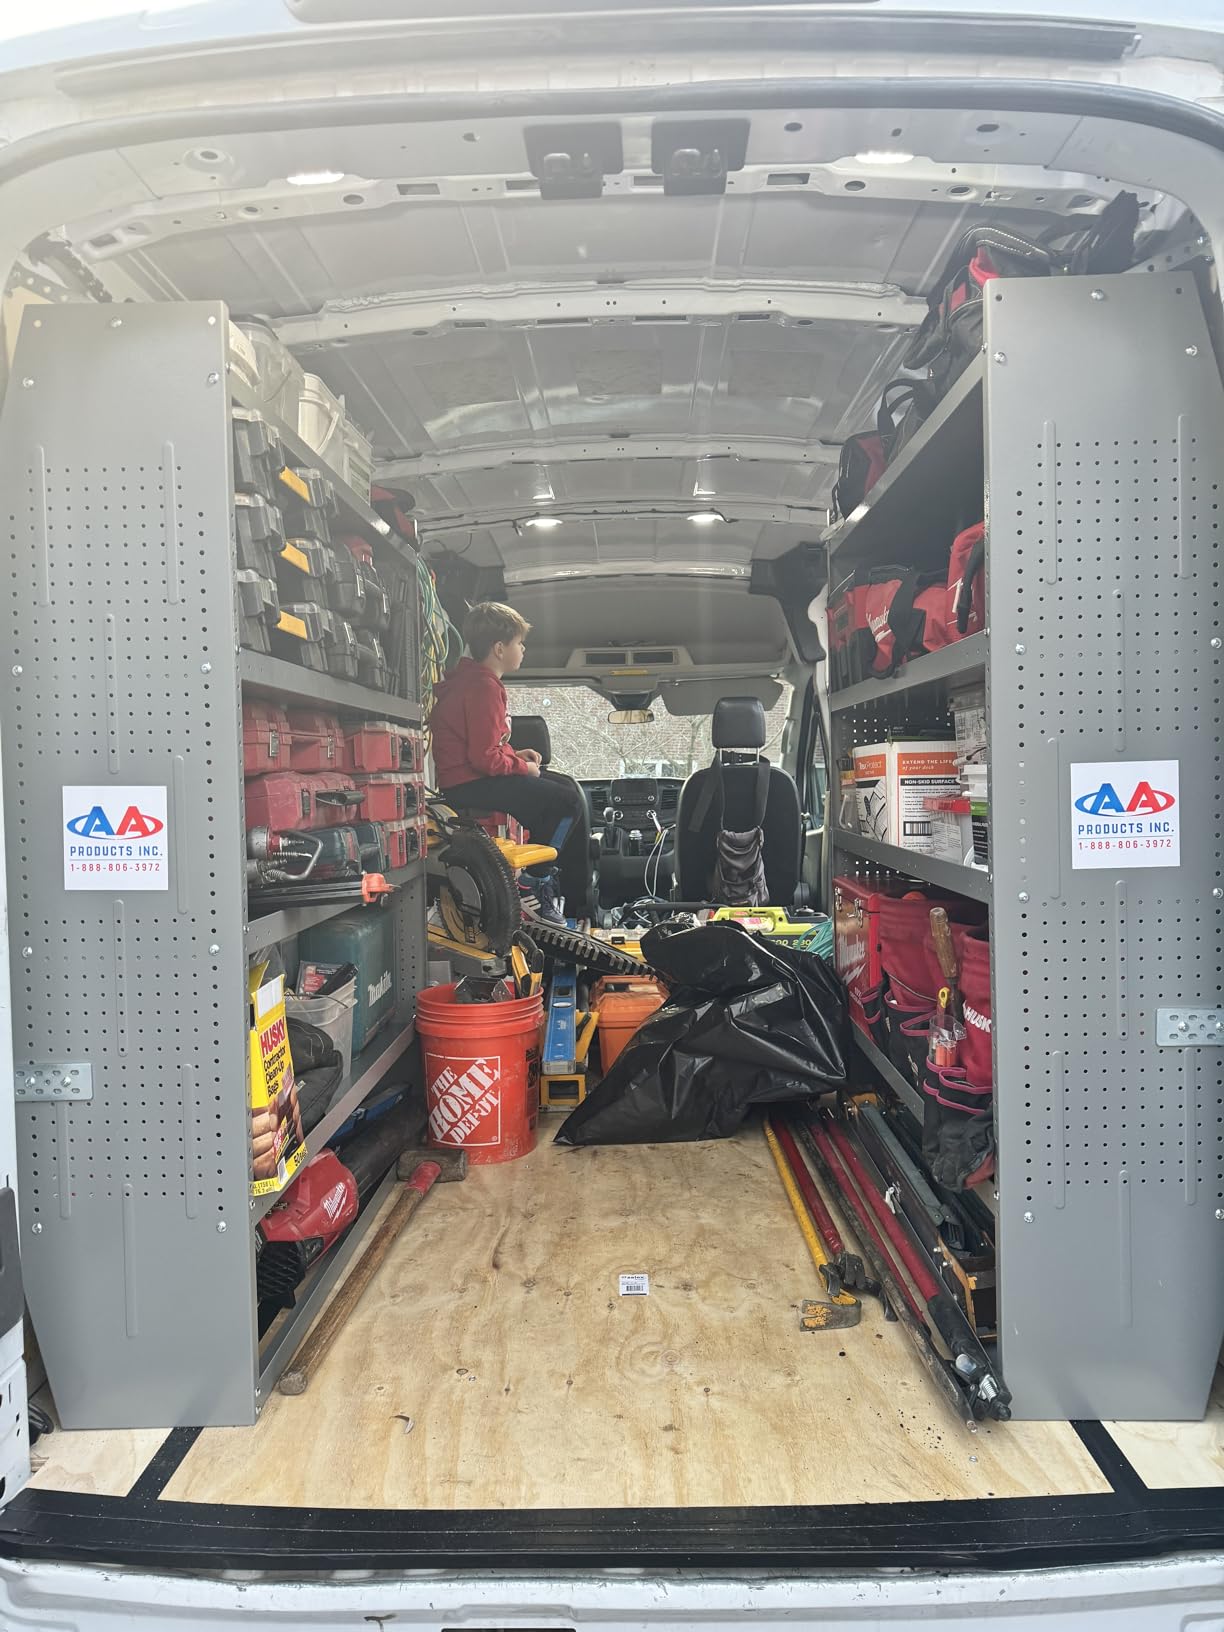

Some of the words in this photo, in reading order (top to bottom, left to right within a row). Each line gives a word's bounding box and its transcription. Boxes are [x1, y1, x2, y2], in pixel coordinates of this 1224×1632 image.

[1086, 781, 1164, 815] AA
[78, 805, 154, 837] AA
[1078, 822, 1143, 835] PRODUCTS
[1149, 821, 1175, 833] INC.
[70, 845, 133, 856] PRODUCTS
[138, 845, 163, 856] INC.
[1078, 839, 1172, 850] 1-888-806-3972
[70, 863, 160, 872] 1-888-806-3972
[260, 1015, 286, 1058] HUSKY
[263, 1045, 286, 1072] Contractor
[266, 1060, 285, 1084] Clean-Up
[267, 1080, 279, 1098] Bags
[431, 1066, 458, 1099] THE
[429, 1059, 500, 1141] HOME
[449, 1089, 500, 1145] DEPOT
